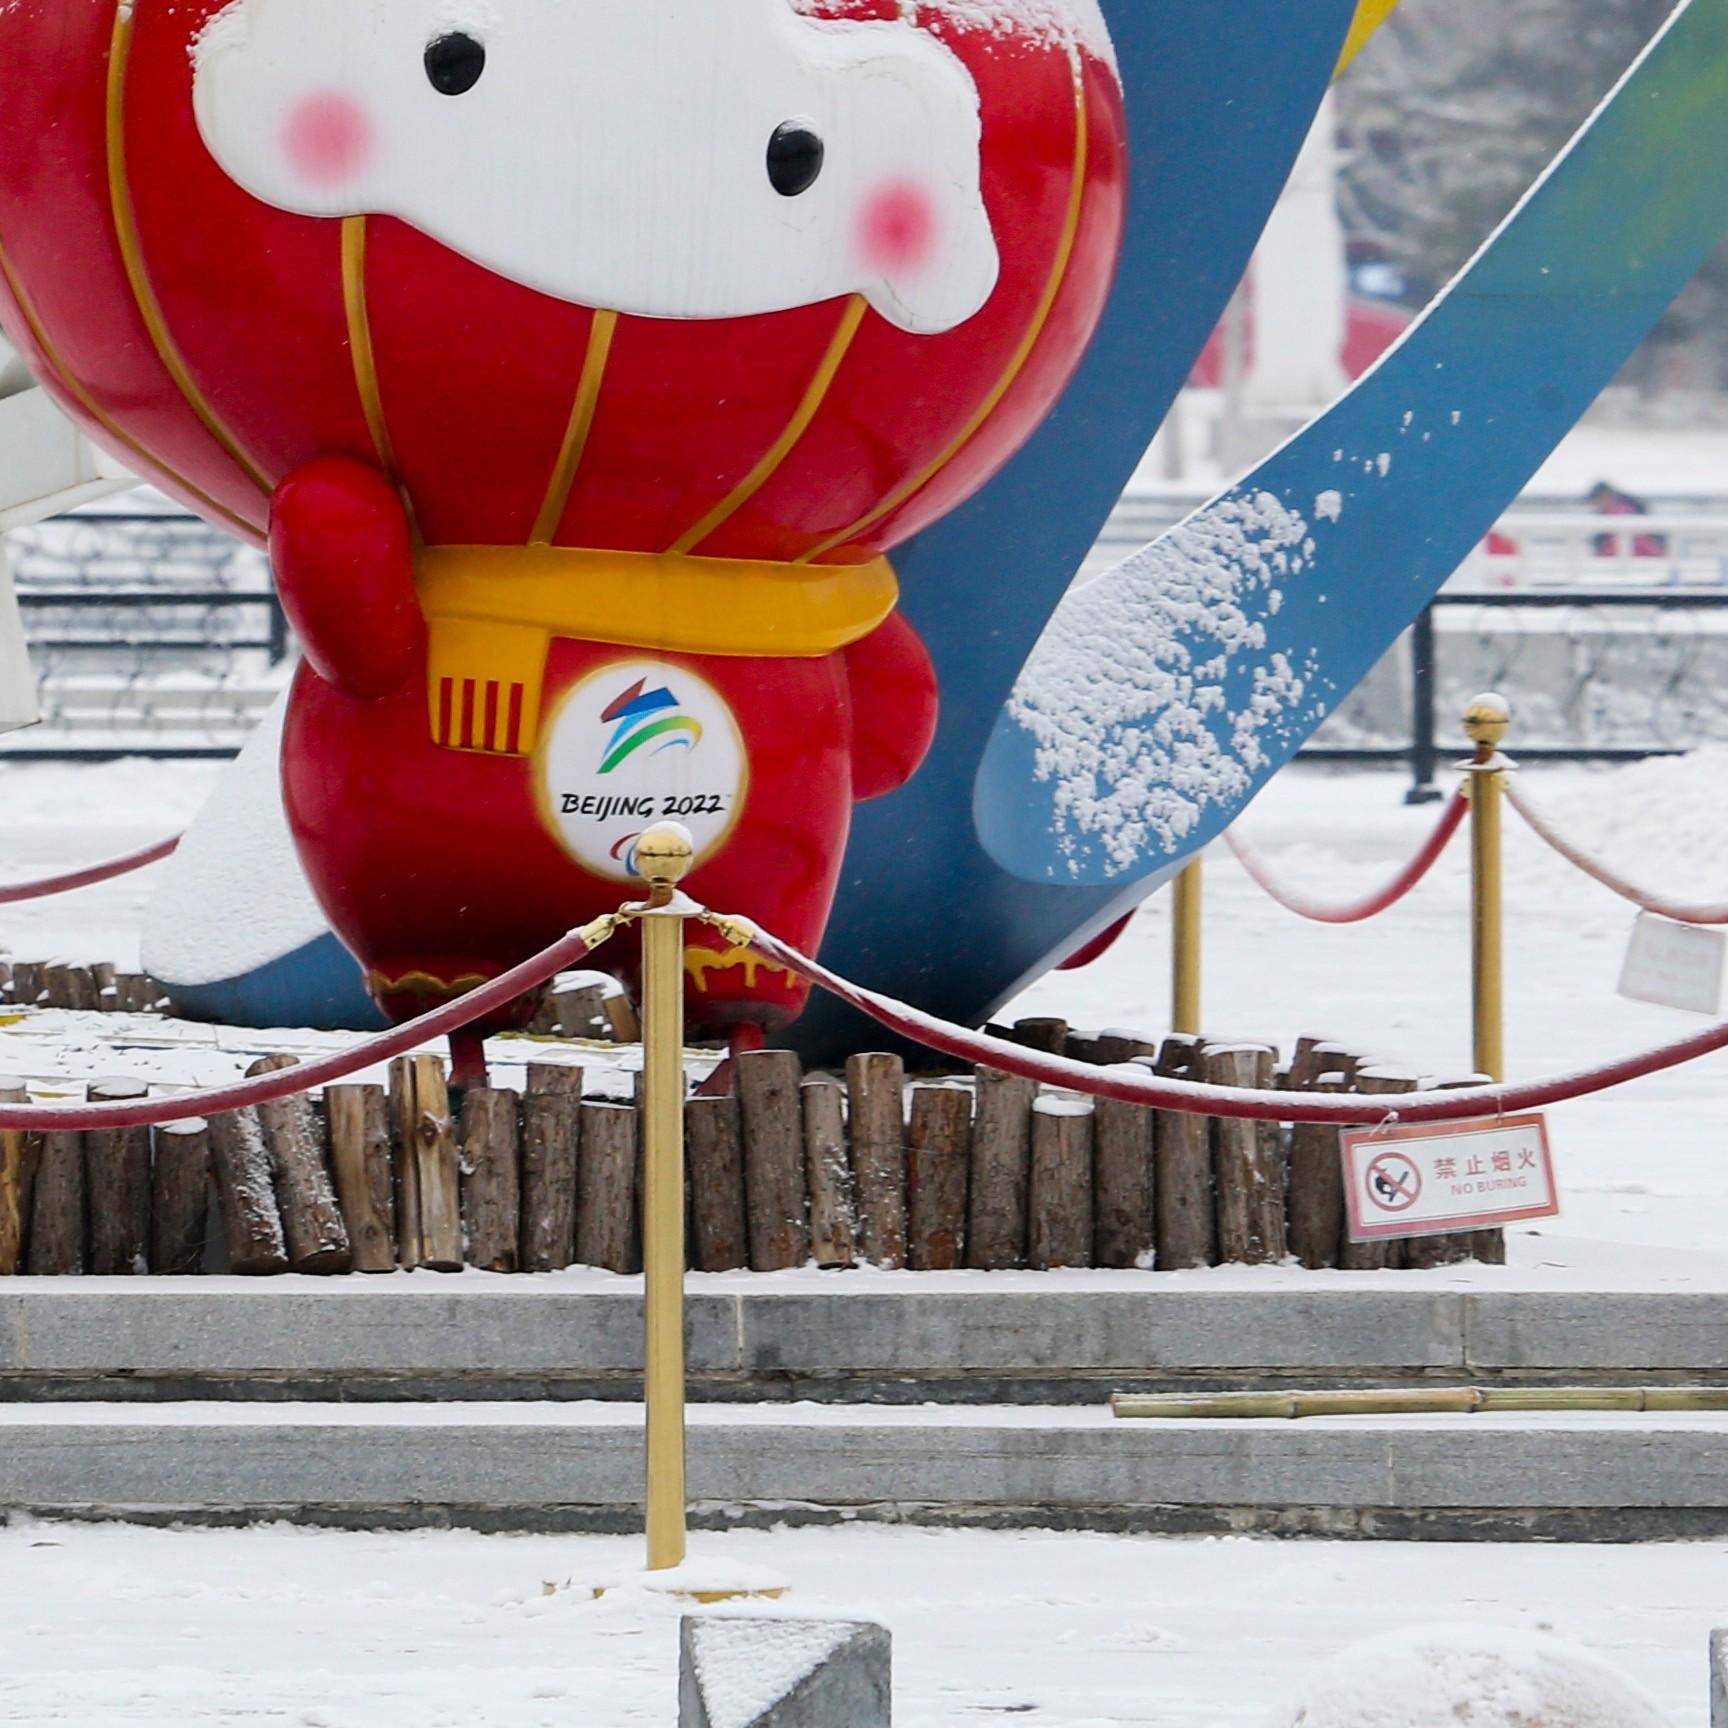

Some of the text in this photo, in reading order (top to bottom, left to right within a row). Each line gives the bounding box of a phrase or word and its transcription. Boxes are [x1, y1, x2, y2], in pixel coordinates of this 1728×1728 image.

[561, 793, 726, 822] BEIJING 2022
[1434, 1148, 1536, 1179] 禁止烟火
[1451, 1183, 1473, 1195] NO
